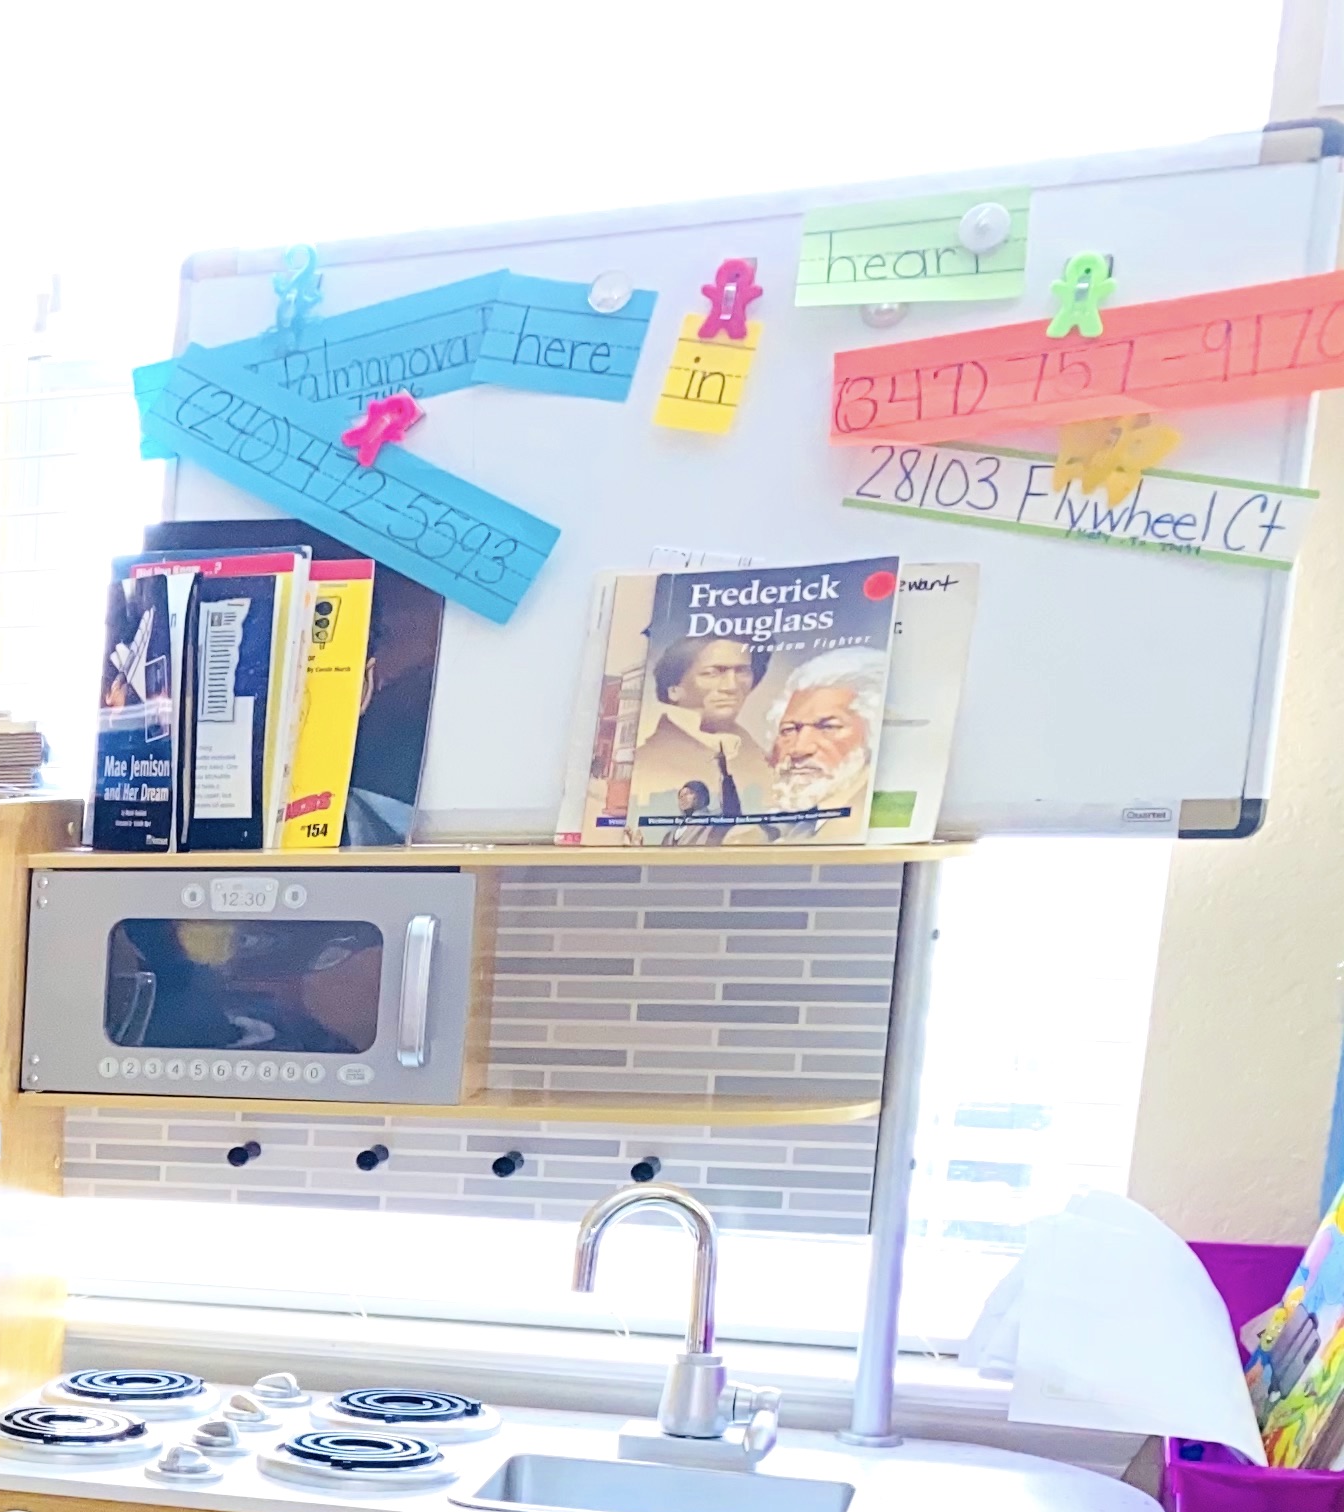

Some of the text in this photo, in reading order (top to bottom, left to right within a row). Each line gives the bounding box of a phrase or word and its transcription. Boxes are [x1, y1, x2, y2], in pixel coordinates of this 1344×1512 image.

[514, 307, 611, 374] here
[278, 332, 474, 402] Palmanova
[684, 356, 725, 401] in
[688, 574, 841, 608] Frederick
[686, 608, 834, 643] Douglass
[741, 634, 872, 654] Freedom Fighter
[104, 754, 170, 780] Mae Jemison
[104, 783, 169, 801] and Her Dream
[307, 824, 329, 838] 154
[221, 892, 265, 907] 12:30
